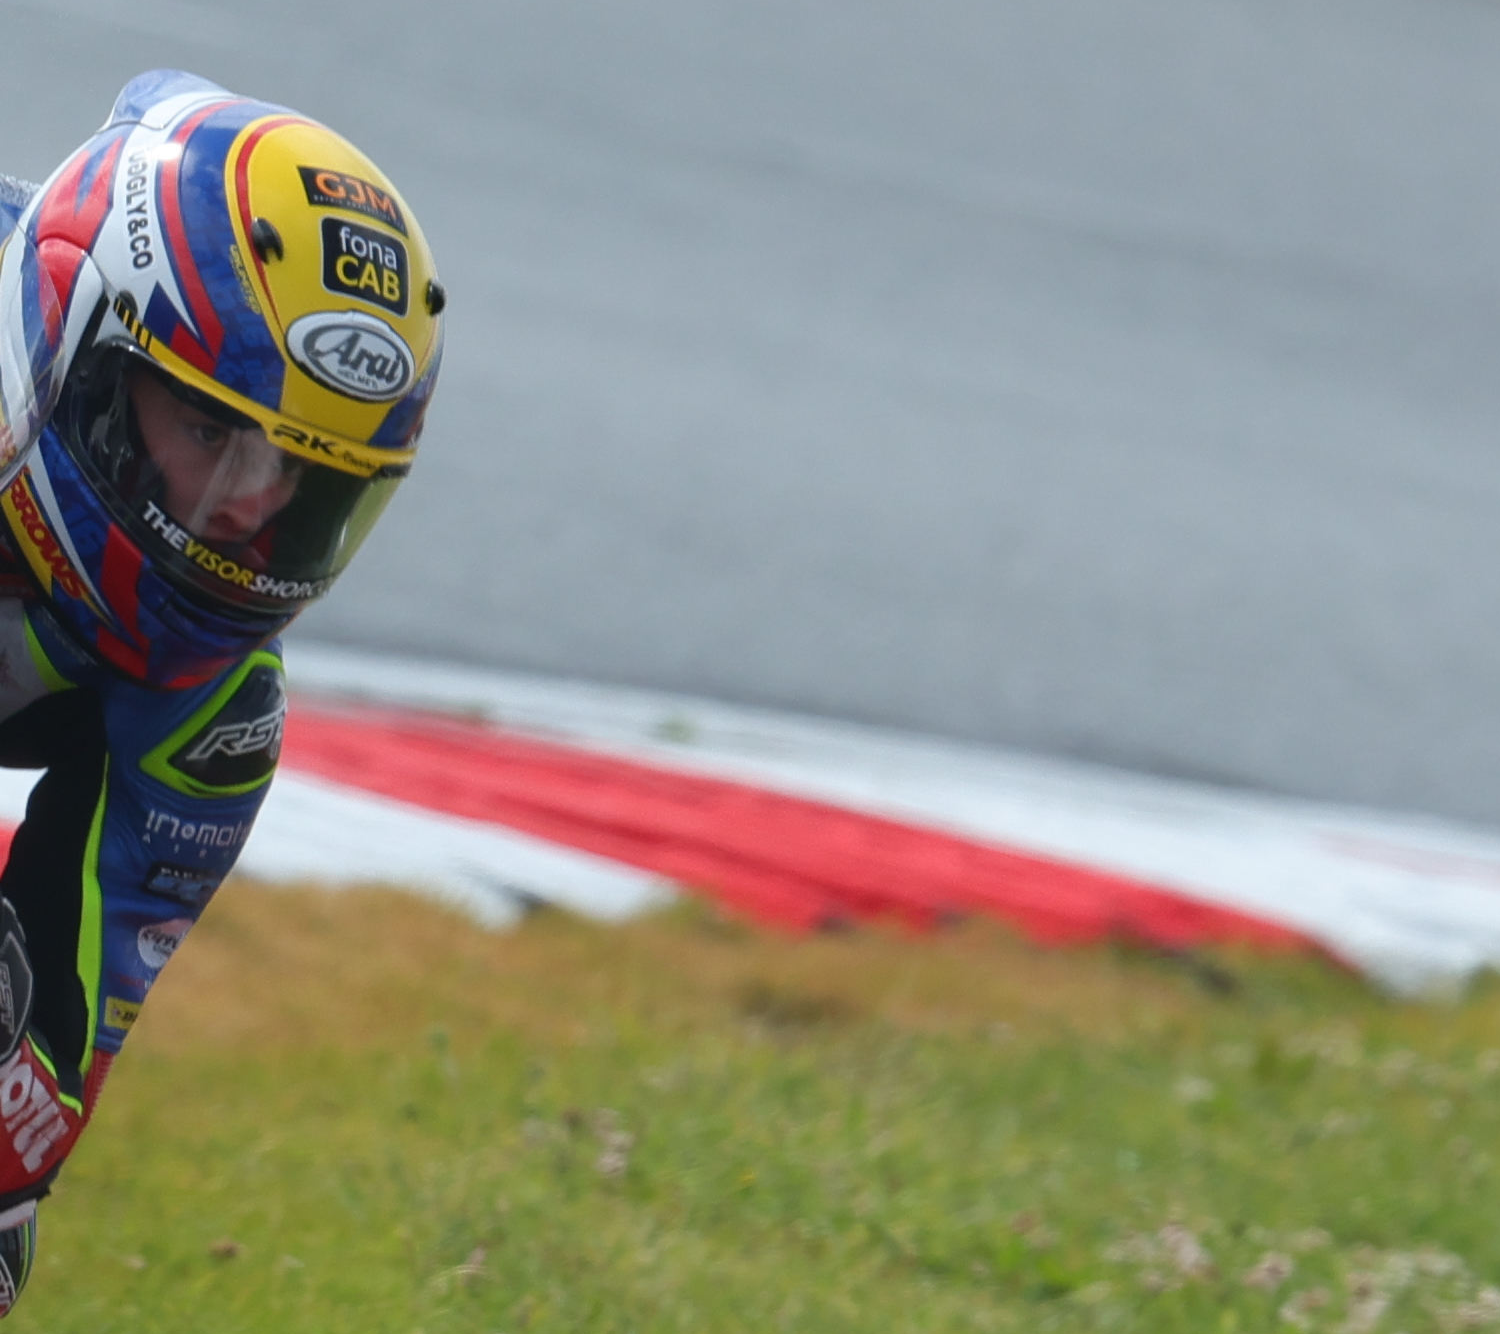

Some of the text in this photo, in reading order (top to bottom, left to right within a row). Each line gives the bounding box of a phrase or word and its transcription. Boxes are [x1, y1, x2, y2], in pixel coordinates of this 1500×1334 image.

[315, 171, 398, 221] GJM
[339, 226, 399, 269] fona
[336, 254, 400, 302] CAB
[308, 324, 402, 383] Arai
[272, 423, 336, 457] RK
